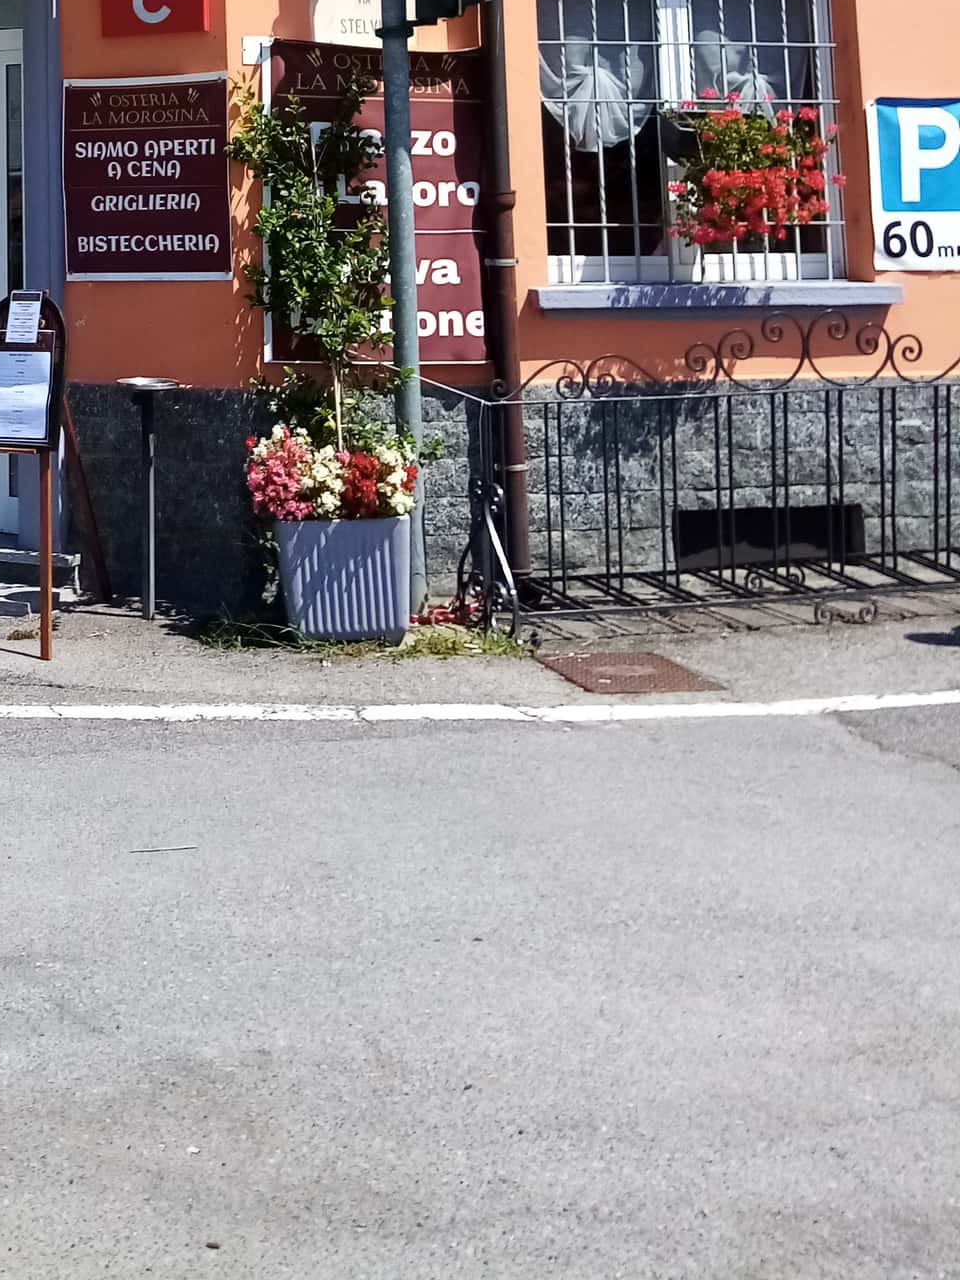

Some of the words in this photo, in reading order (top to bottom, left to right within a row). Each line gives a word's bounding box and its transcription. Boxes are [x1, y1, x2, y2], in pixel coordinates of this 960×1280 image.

[340, 18, 381, 35] STELV
[295, 72, 328, 91] LA
[108, 92, 180, 108] OSTERIA
[81, 110, 103, 126] LA
[108, 107, 210, 125] MOROSINA
[74, 140, 139, 161] SIAMO
[144, 138, 216, 159] APERTI
[896, 106, 960, 203] P
[107, 161, 122, 180] A
[126, 160, 181, 179] CENA
[90, 192, 201, 213] GRIGLIERIA
[77, 233, 220, 254] BISTECCHERIA
